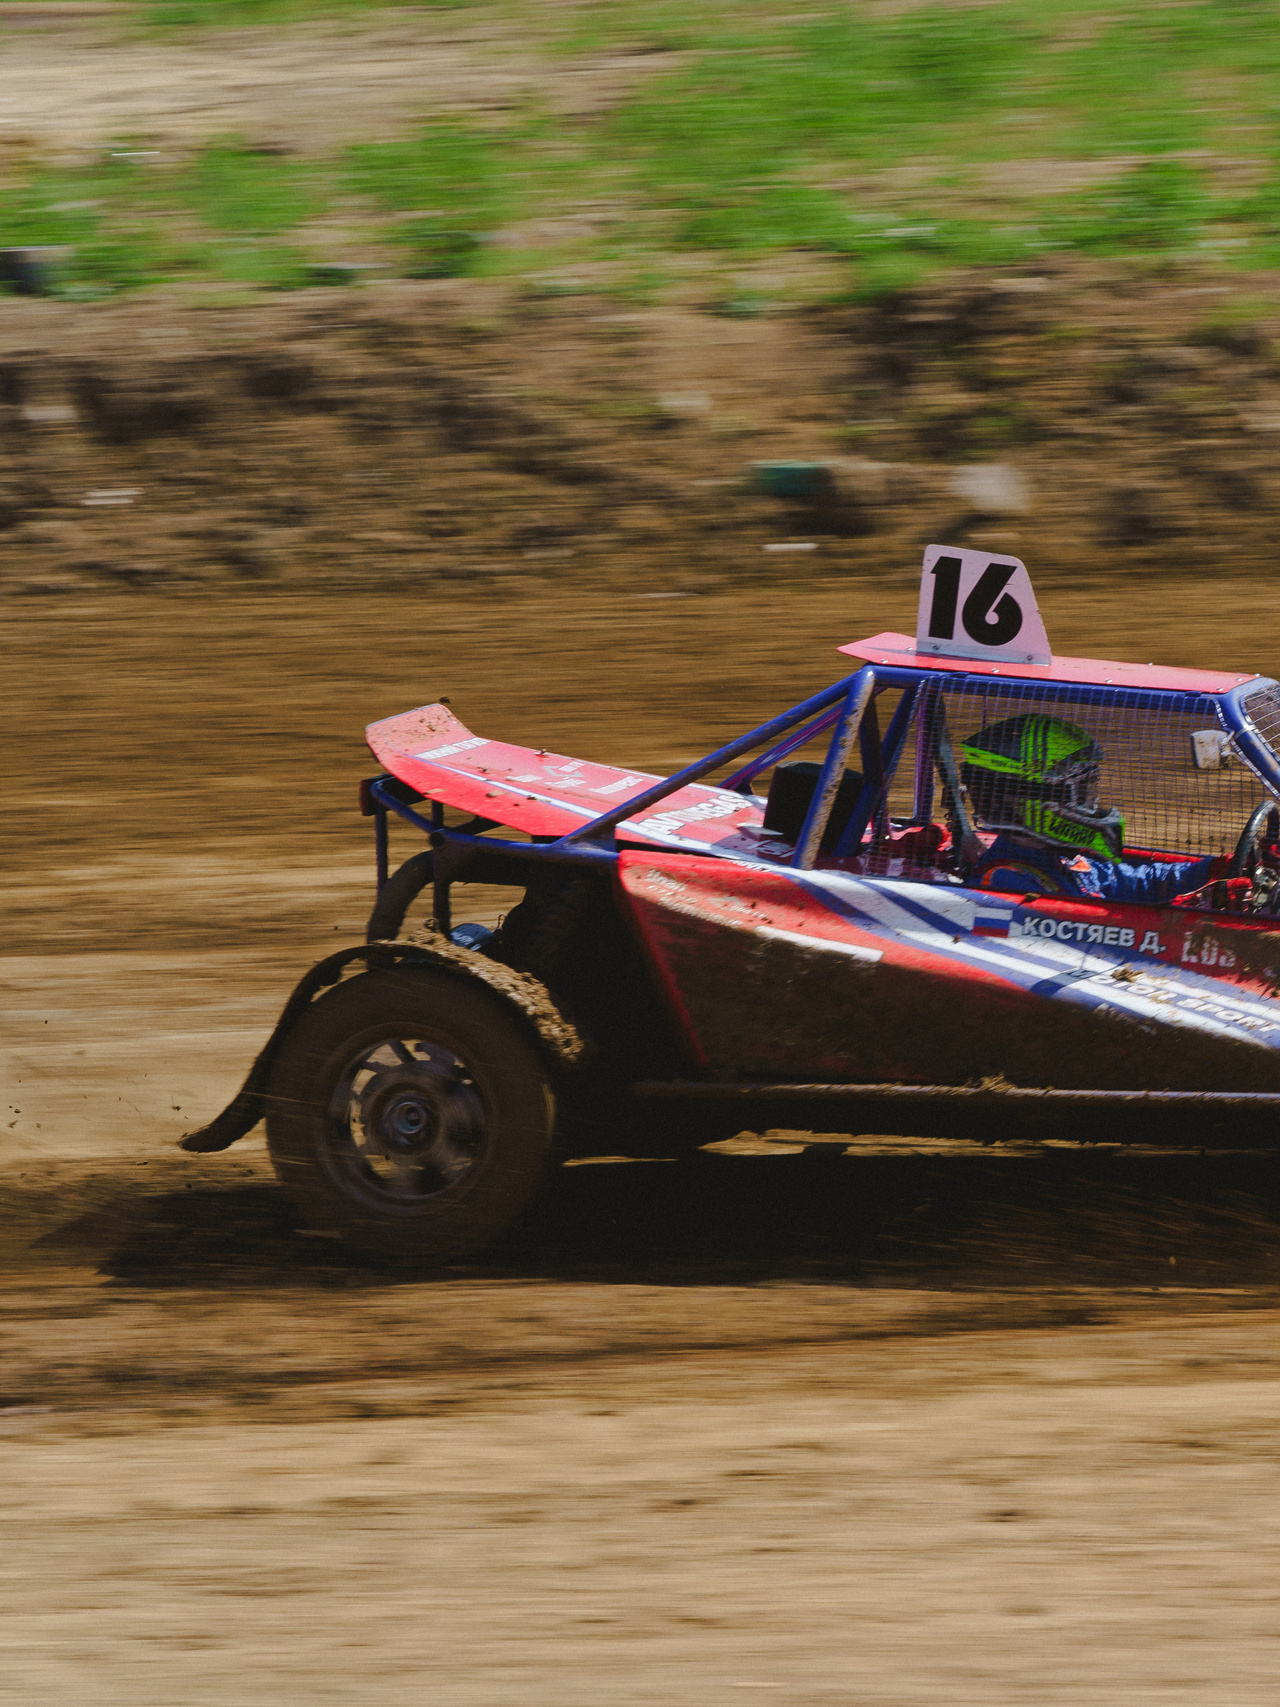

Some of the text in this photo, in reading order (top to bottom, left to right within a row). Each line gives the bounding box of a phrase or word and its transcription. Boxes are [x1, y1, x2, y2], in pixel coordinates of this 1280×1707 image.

[929, 556, 1023, 646] 16
[1023, 916, 1136, 948] КОСТЯЕВ
[1138, 931, 1167, 954] Д.
